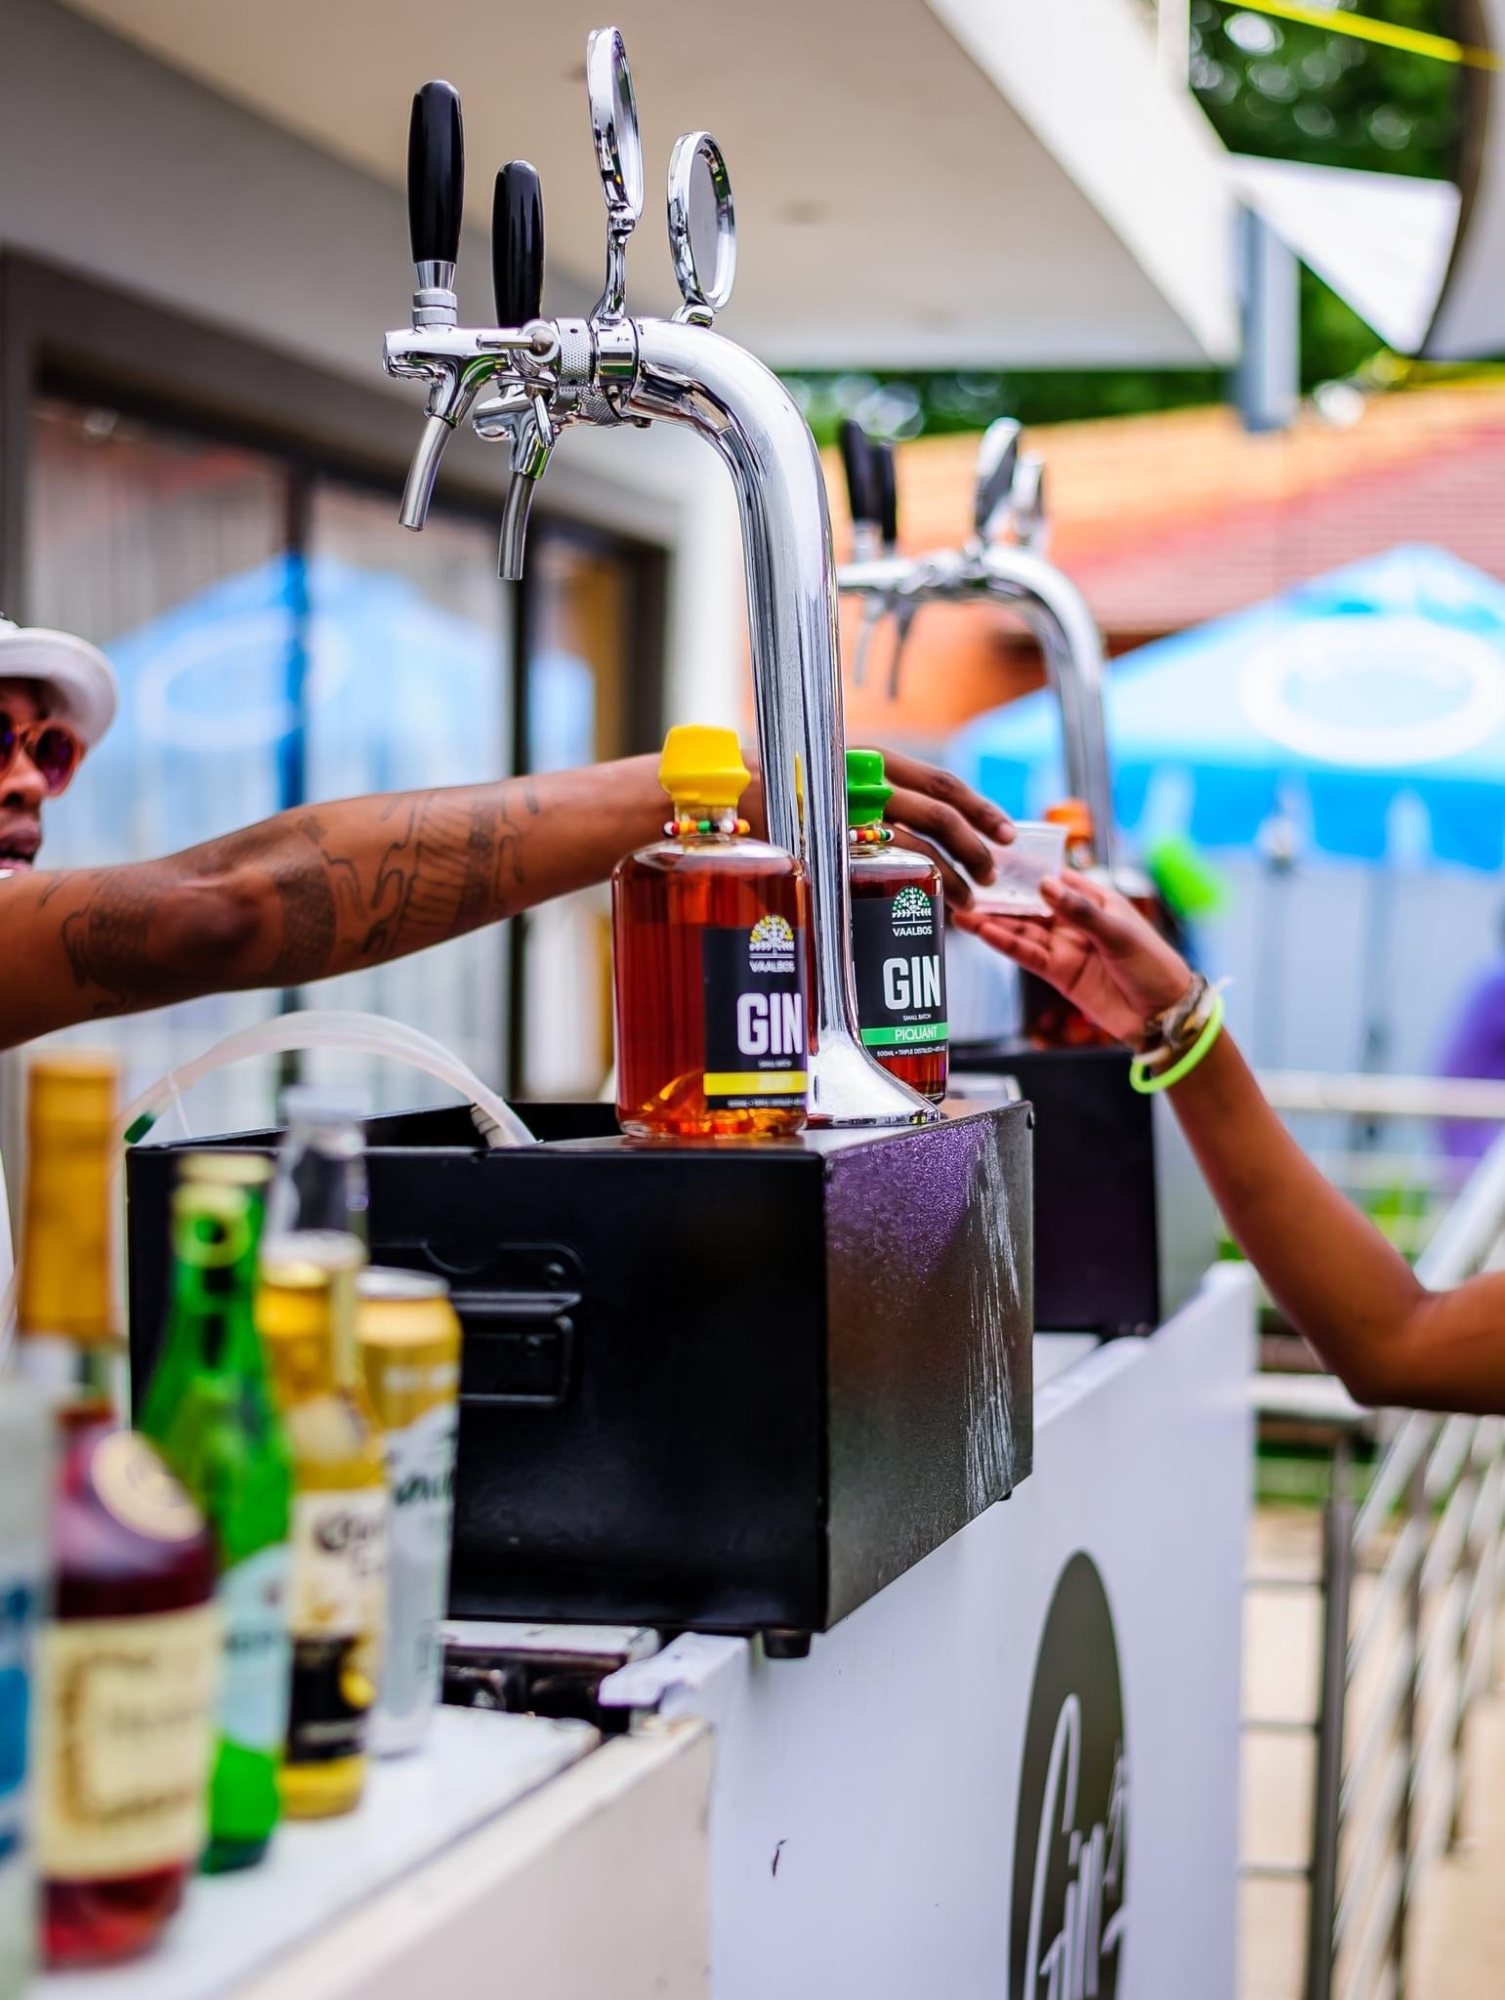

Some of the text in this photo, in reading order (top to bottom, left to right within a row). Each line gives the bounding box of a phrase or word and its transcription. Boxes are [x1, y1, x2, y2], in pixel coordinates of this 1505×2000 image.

[892, 926, 933, 937] VAALBOS
[883, 955, 941, 1010] GIN
[737, 993, 803, 1055] GIN
[894, 1026, 937, 1041] PIQUANT
